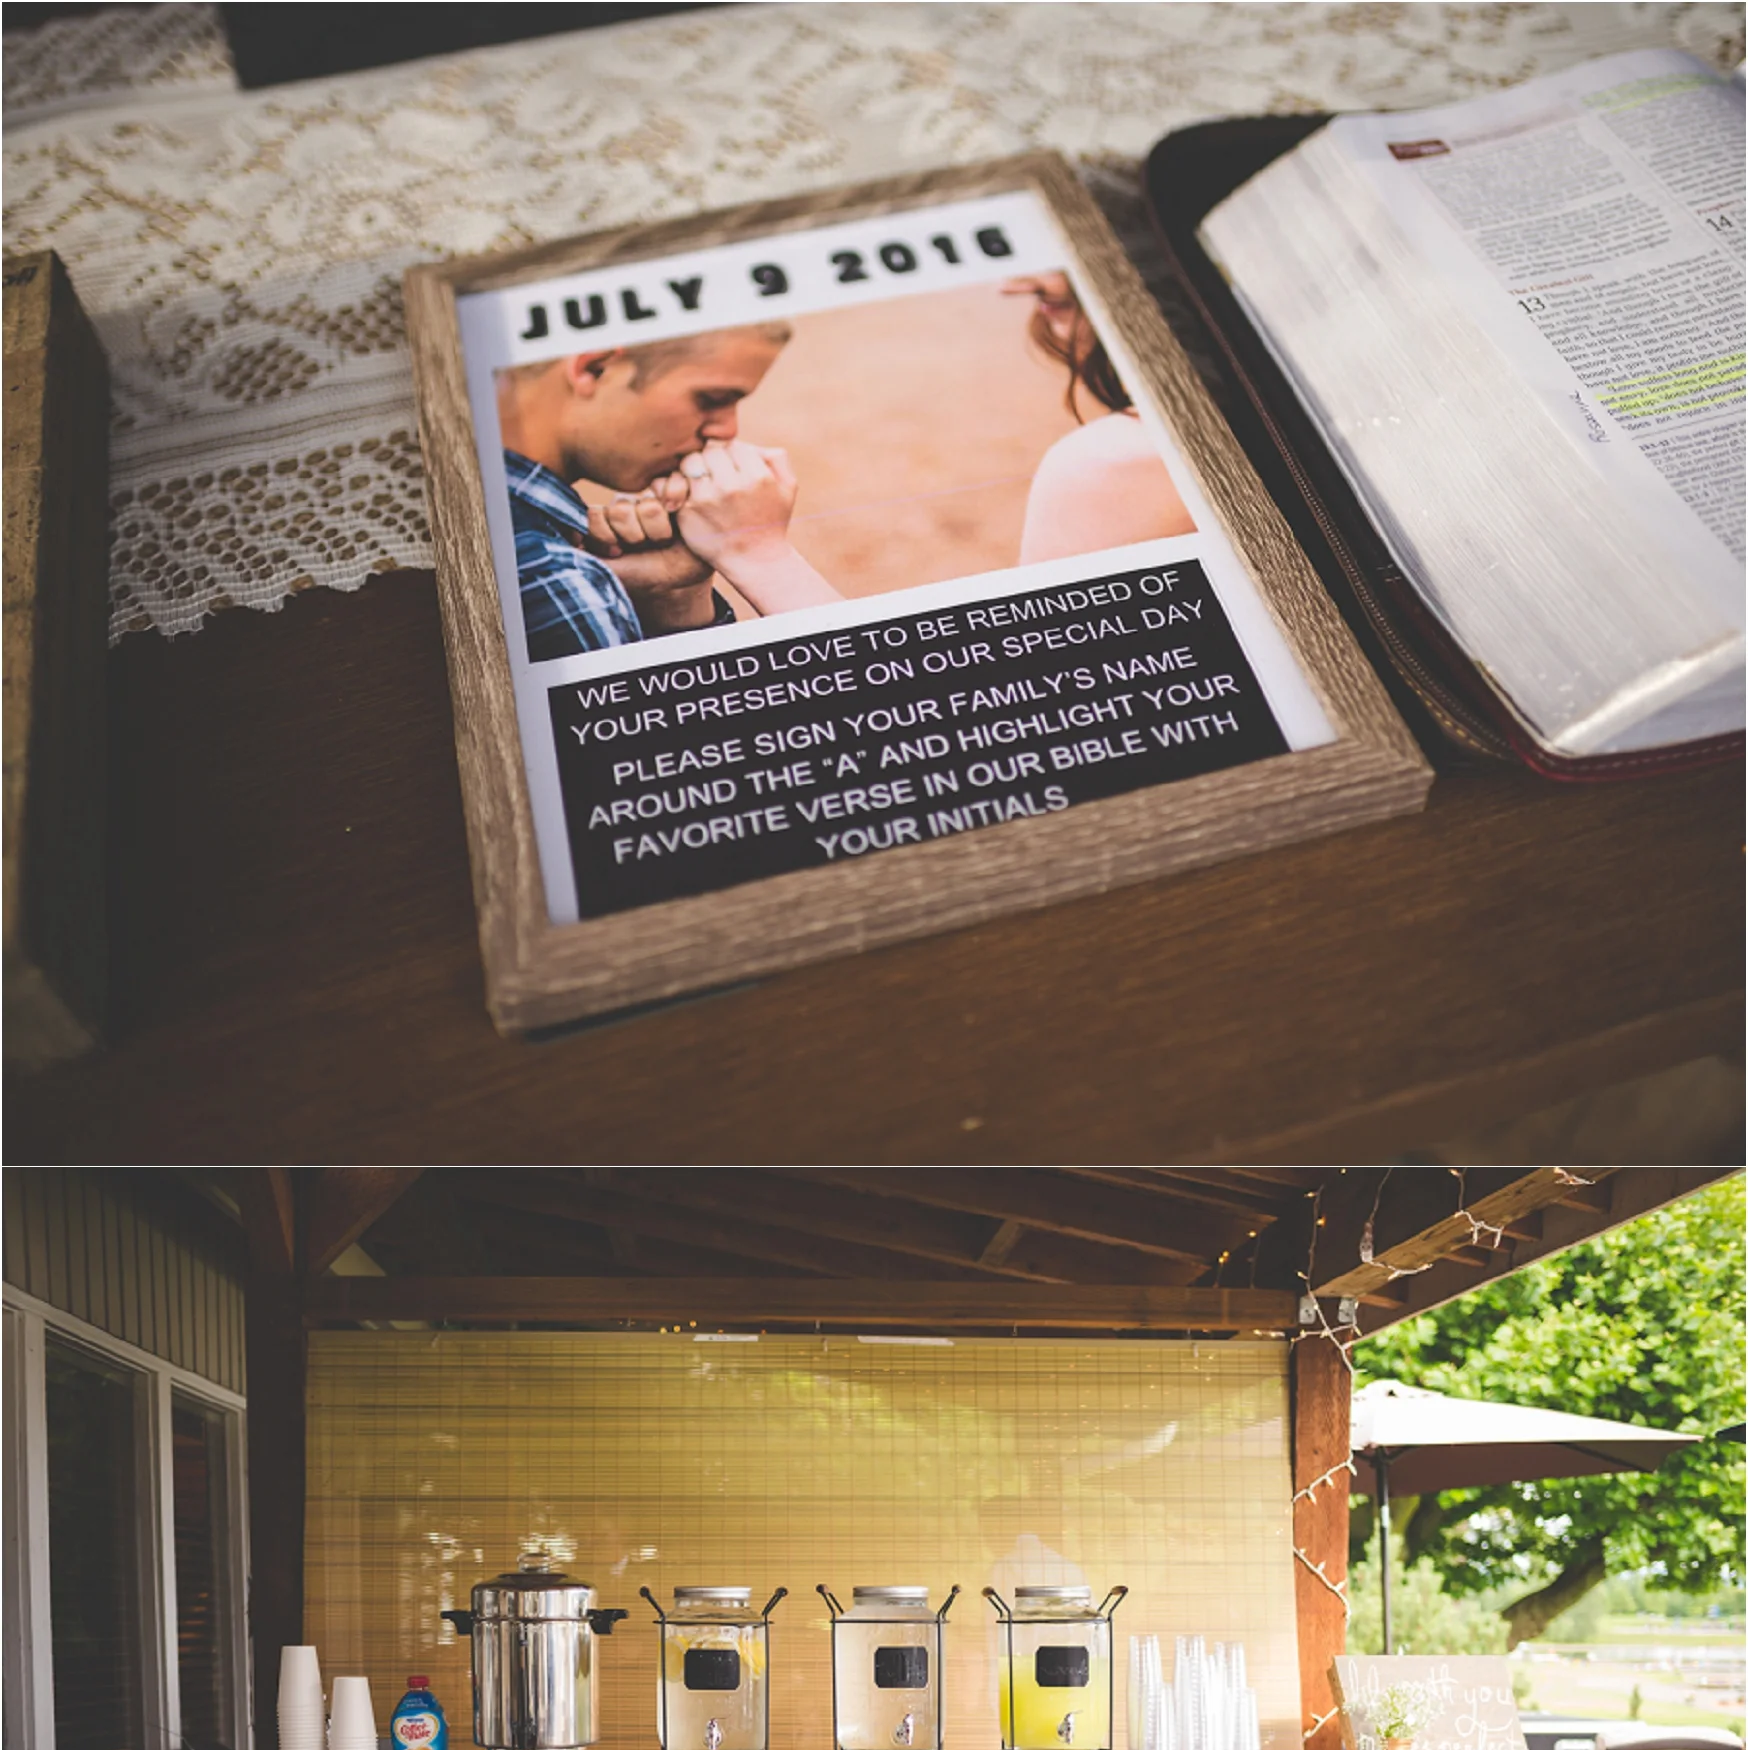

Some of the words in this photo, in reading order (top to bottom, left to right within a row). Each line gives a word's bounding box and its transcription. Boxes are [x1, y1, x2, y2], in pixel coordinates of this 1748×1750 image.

[519, 275, 704, 341] JULY
[751, 263, 789, 297] 9
[830, 226, 1014, 284] 2016
[1518, 297, 1546, 315] 13
[571, 709, 667, 744] YOUR
[676, 670, 857, 724] PRESENCE
[866, 659, 914, 684] ON
[923, 643, 995, 672] OUR
[1002, 616, 1137, 657] SPECIAL
[1141, 600, 1201, 629] DAY
[578, 681, 630, 708] WE
[639, 657, 759, 695] WOULD
[769, 636, 855, 670] LOVE
[861, 628, 907, 650] TO
[917, 616, 959, 640] BE
[967, 583, 1131, 630] REMINDED
[1140, 571, 1179, 595] OF
[590, 780, 736, 828] AROUND
[745, 762, 815, 794] THE
[881, 735, 949, 768] AND
[957, 694, 1133, 751] HIGHLIGHT
[1142, 675, 1239, 709] YOUR
[614, 739, 744, 785] PLEASE
[755, 721, 835, 755] SIGN
[843, 700, 942, 736] YOUR
[1103, 647, 1197, 683] NAME
[614, 806, 789, 863] FAVORITE
[796, 780, 916, 822] VERSE
[924, 770, 958, 796] IN
[968, 753, 1045, 786] OUR
[1050, 730, 1147, 769] BIBLE
[1151, 711, 1238, 746] WITH
[816, 818, 919, 857] YOUR
[928, 786, 1068, 833] INITIALS
[1454, 1686, 1515, 1737] you
